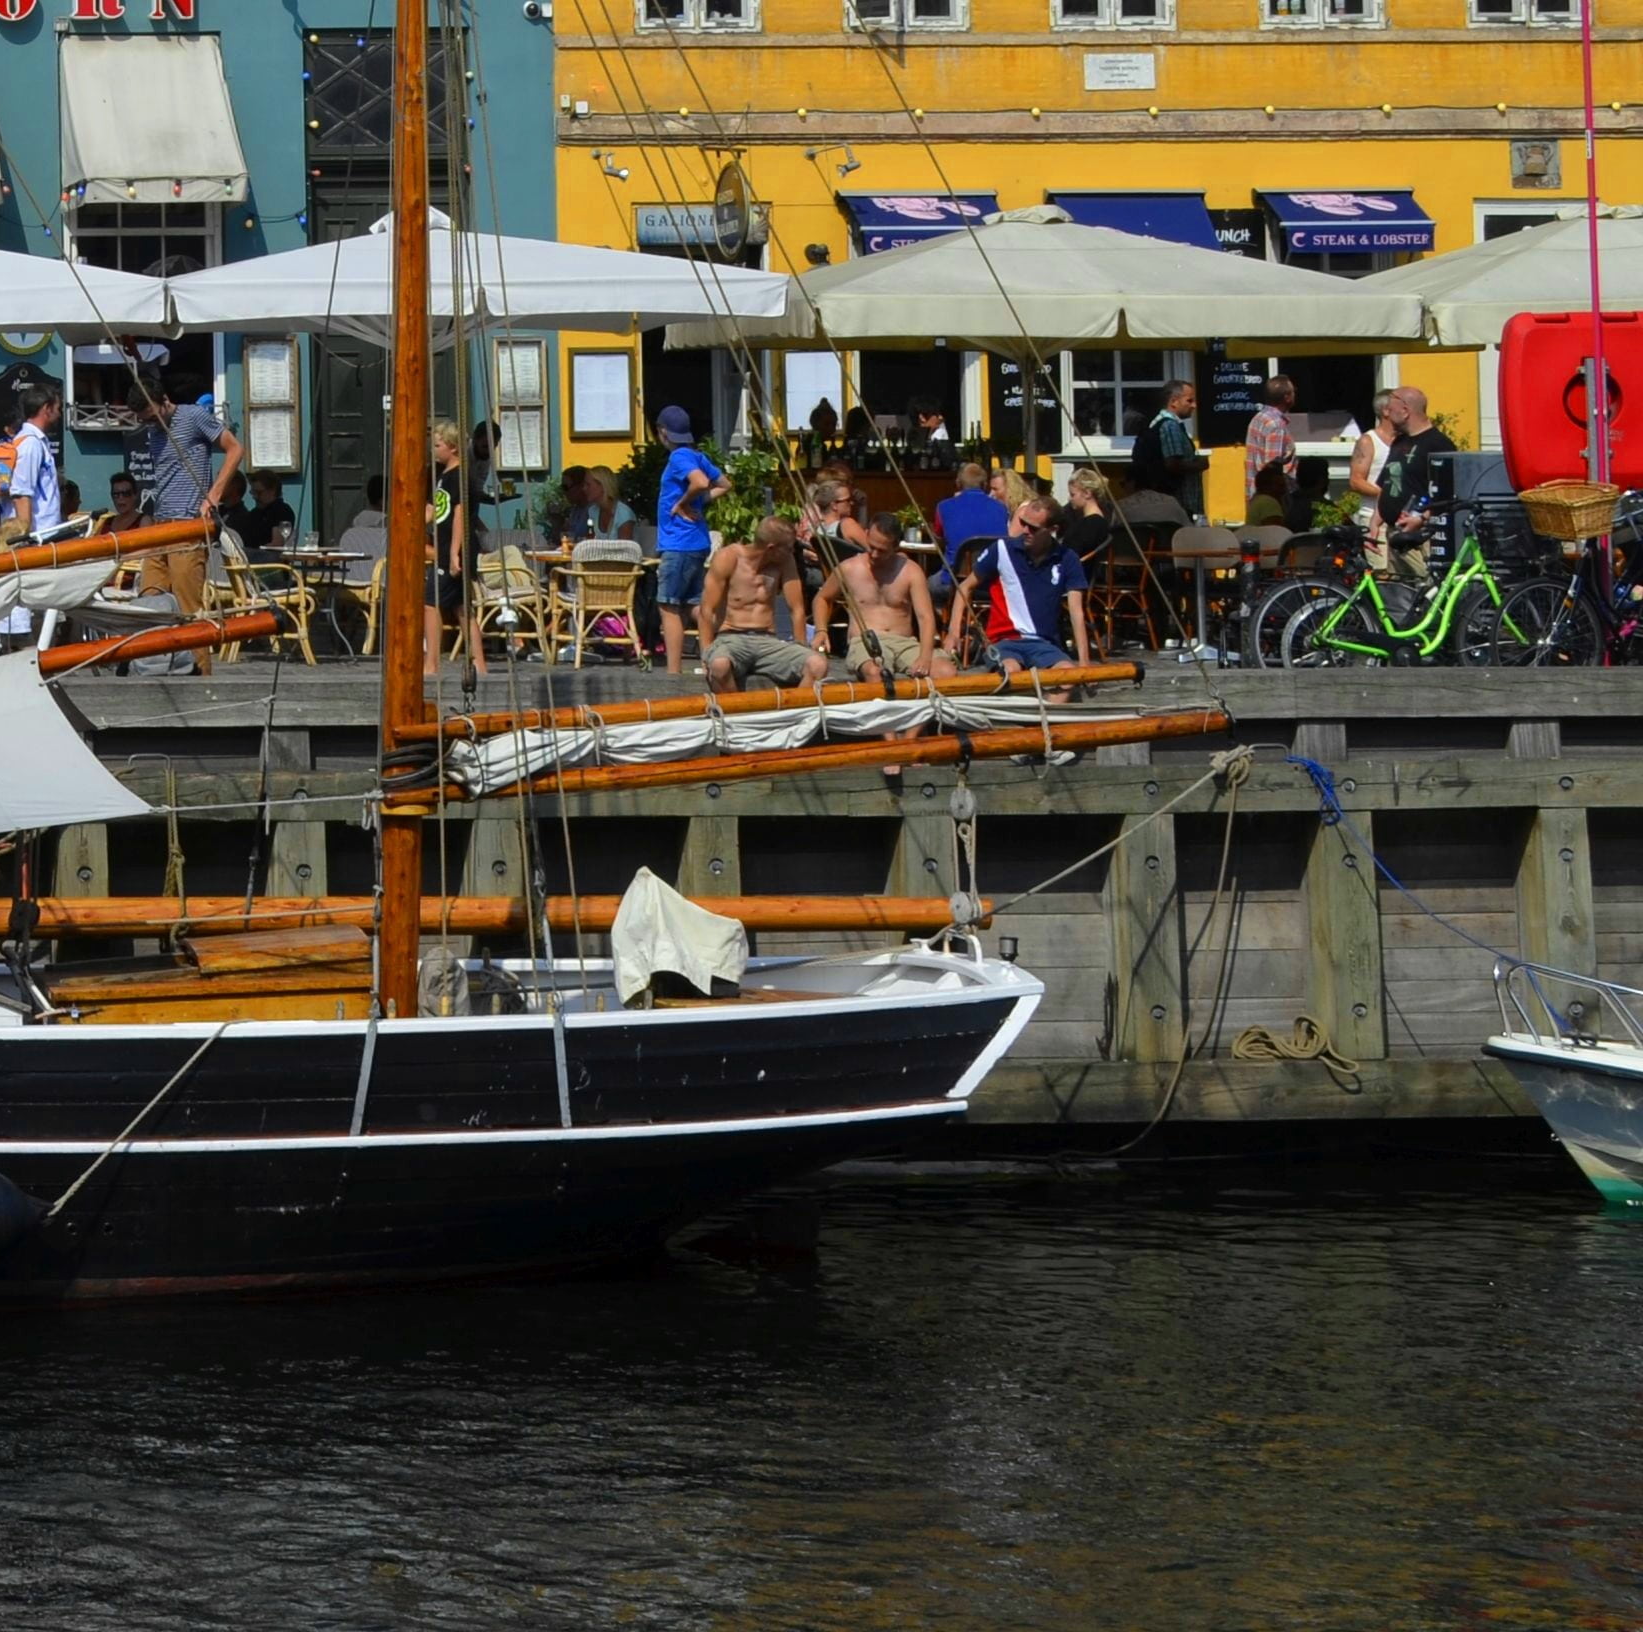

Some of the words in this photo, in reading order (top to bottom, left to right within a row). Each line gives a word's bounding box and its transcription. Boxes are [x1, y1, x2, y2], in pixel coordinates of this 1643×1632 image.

[1214, 227, 1252, 244] UNCH
[1312, 234, 1356, 246] STEAK
[1359, 235, 1369, 246] &
[1373, 233, 1430, 245] LOBSTER
